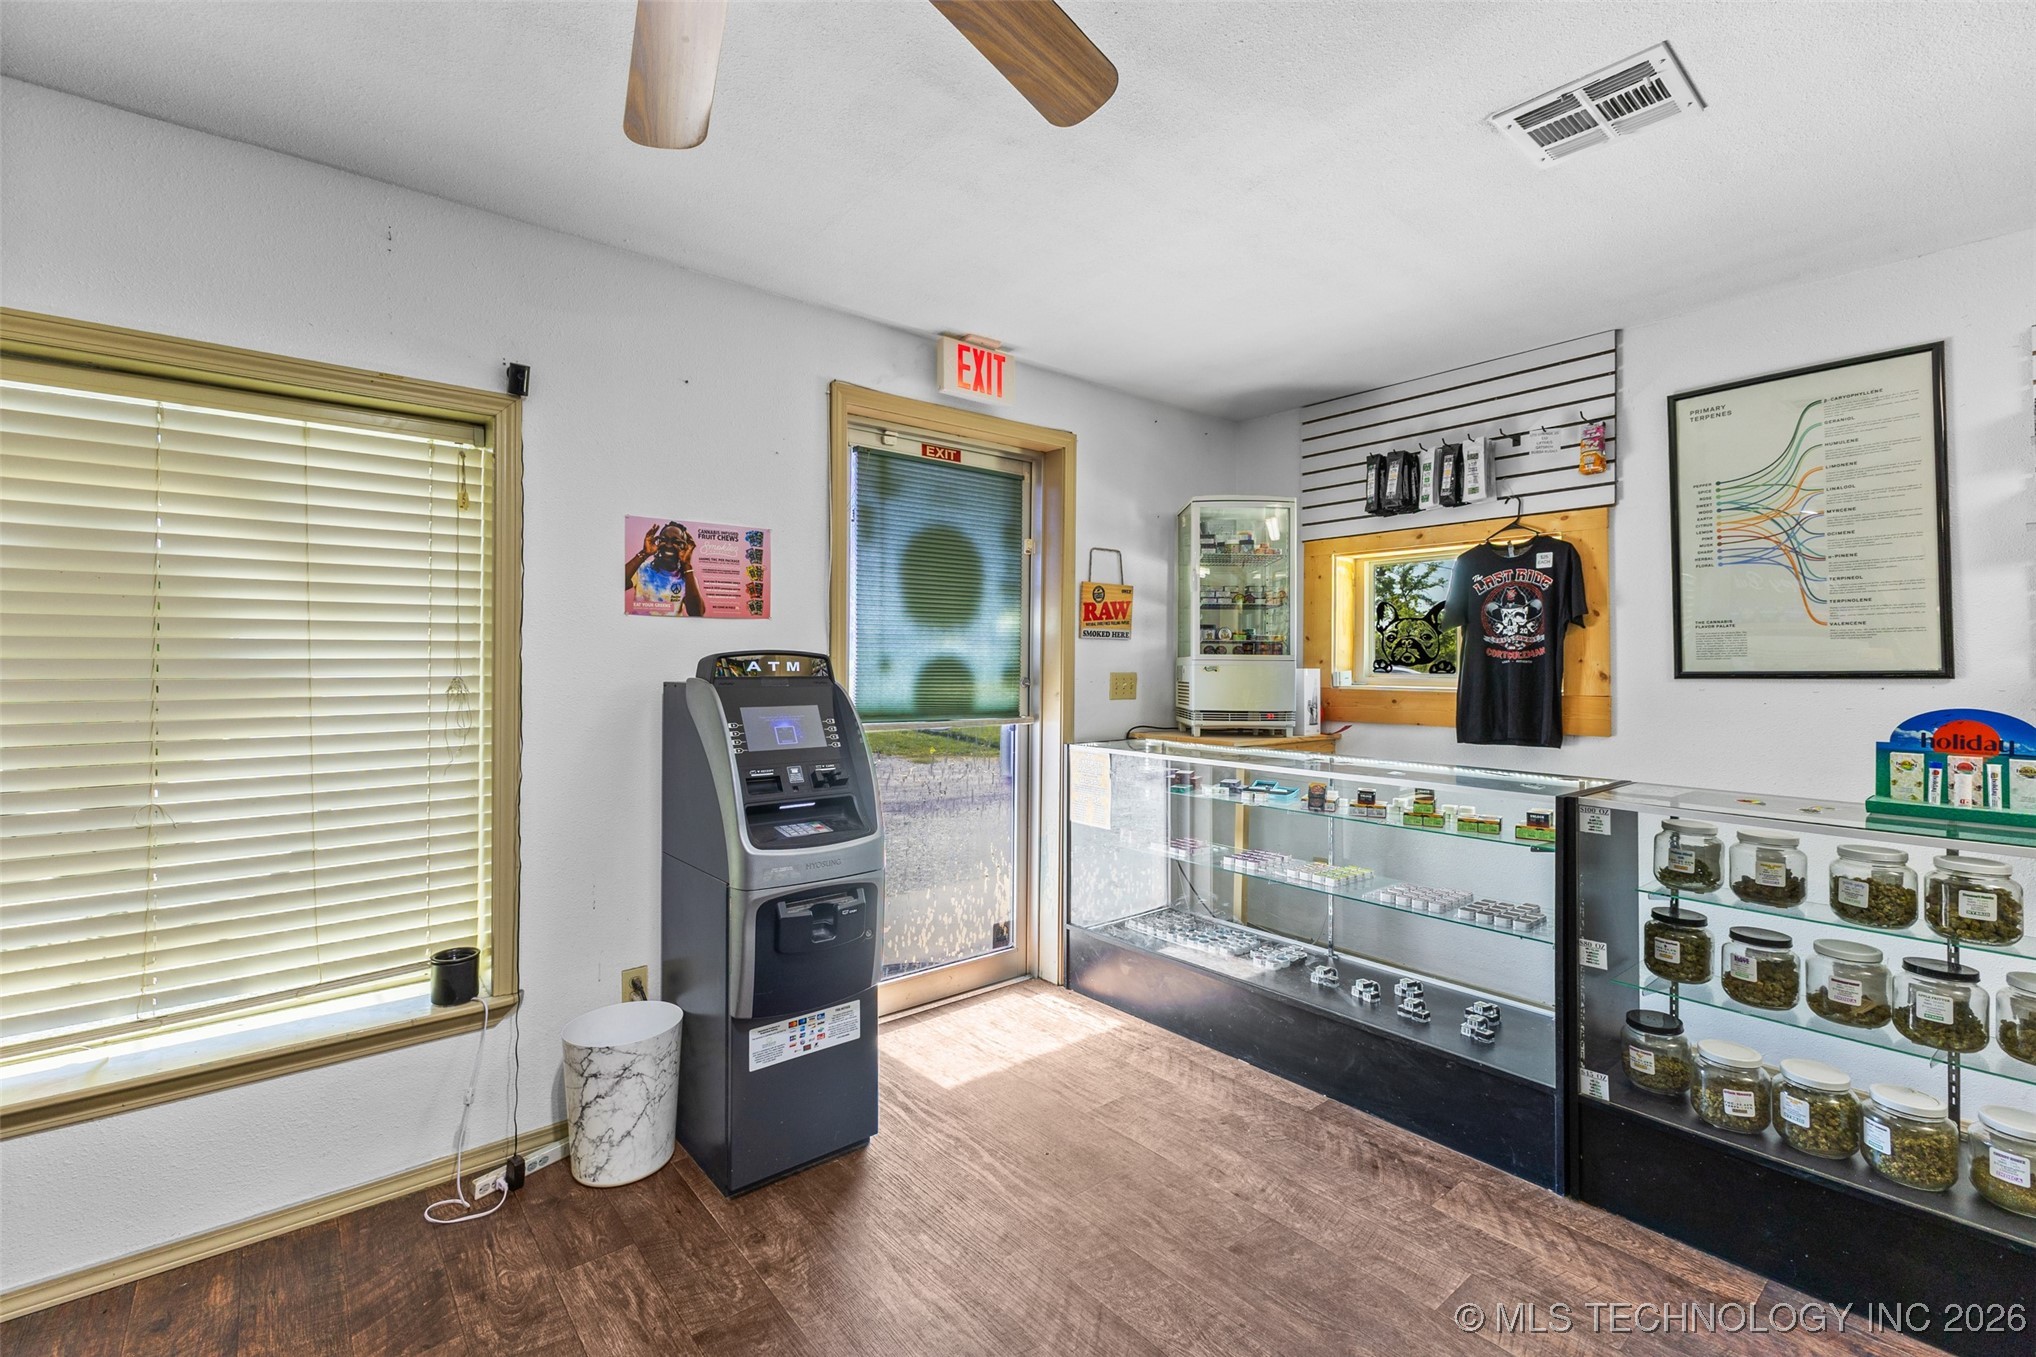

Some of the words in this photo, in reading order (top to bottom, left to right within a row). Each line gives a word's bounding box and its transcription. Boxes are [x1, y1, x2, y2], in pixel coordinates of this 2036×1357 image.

[958, 344, 1006, 398] EXIT
[1690, 404, 1726, 416] PRIMARY
[1690, 410, 1732, 422] TERPENES
[1824, 416, 1856, 425] GERANIOL
[1824, 438, 1859, 447] HUMULENE
[926, 446, 956, 460] EXIT
[1825, 461, 1858, 470] LIMONENE
[1473, 569, 1513, 595] LAST
[1515, 568, 1554, 591] RIDE
[1083, 601, 1132, 621] RAW
[747, 661, 799, 671] ATM
[1921, 733, 2014, 758] holiday
[806, 858, 841, 870] HYOSUNG
[1596, 1074, 1607, 1082] OZ
